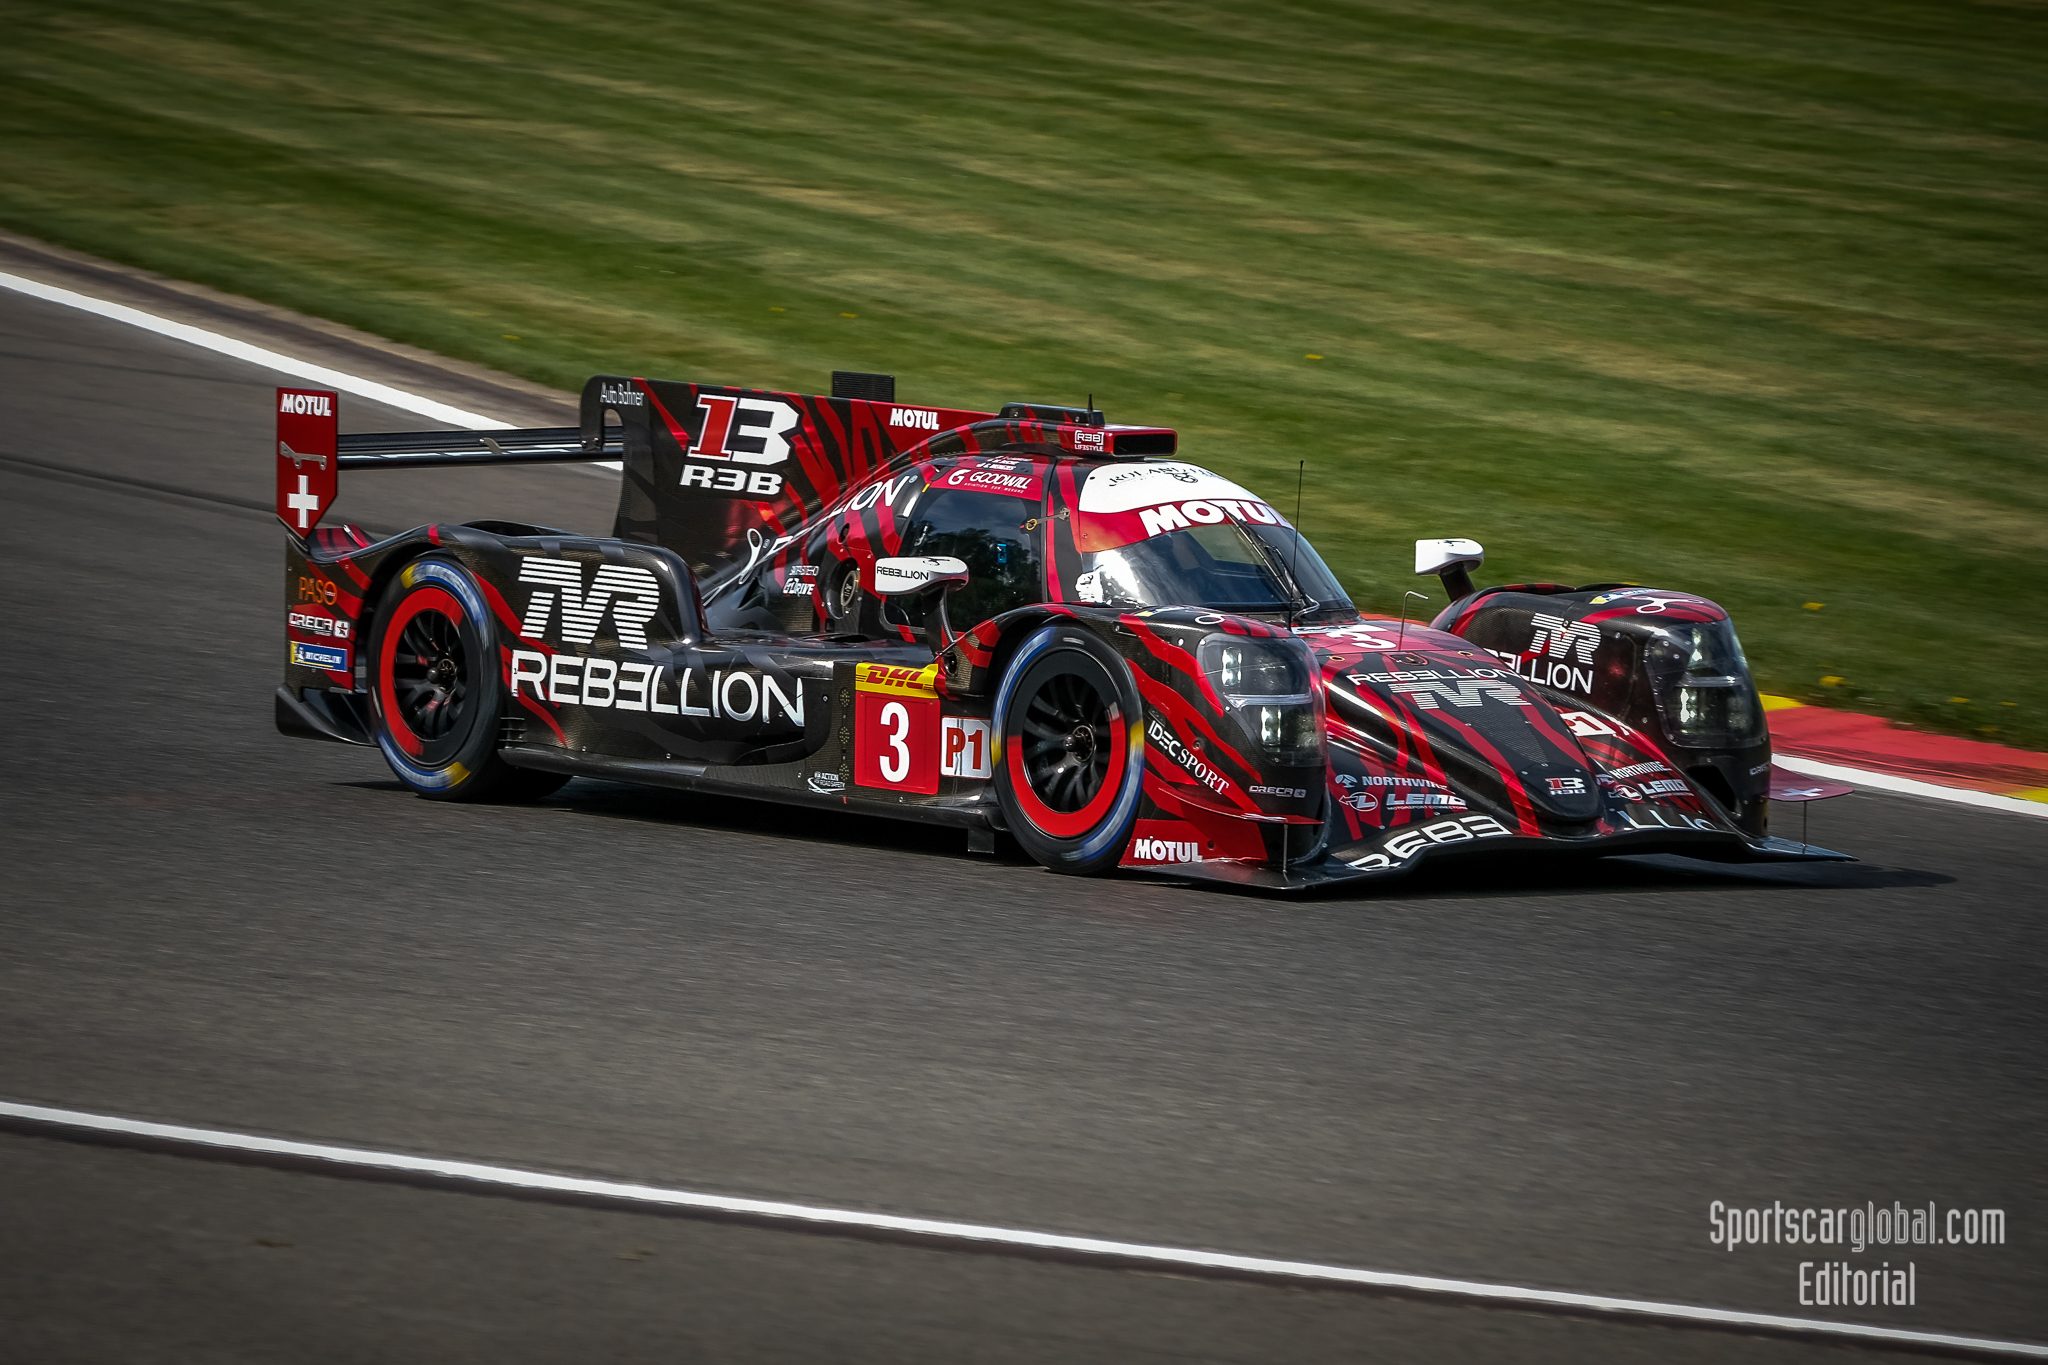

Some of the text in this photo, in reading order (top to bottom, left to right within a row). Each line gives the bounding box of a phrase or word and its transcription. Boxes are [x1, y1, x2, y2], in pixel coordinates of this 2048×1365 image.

[280, 393, 332, 416] MOTUL
[889, 408, 940, 430] MOTUL
[970, 472, 1032, 489] GOODWILL
[877, 566, 929, 581] REBELLION
[512, 649, 805, 728] REBELLION
[866, 666, 924, 690] DHL
[880, 702, 910, 783] 3
[945, 726, 983, 771] P1
[1148, 720, 1230, 796] IDEC SPORT
[1638, 779, 1690, 796] LEMO
[1386, 794, 1467, 806] LEMO
[1134, 838, 1204, 863] MOTUL
